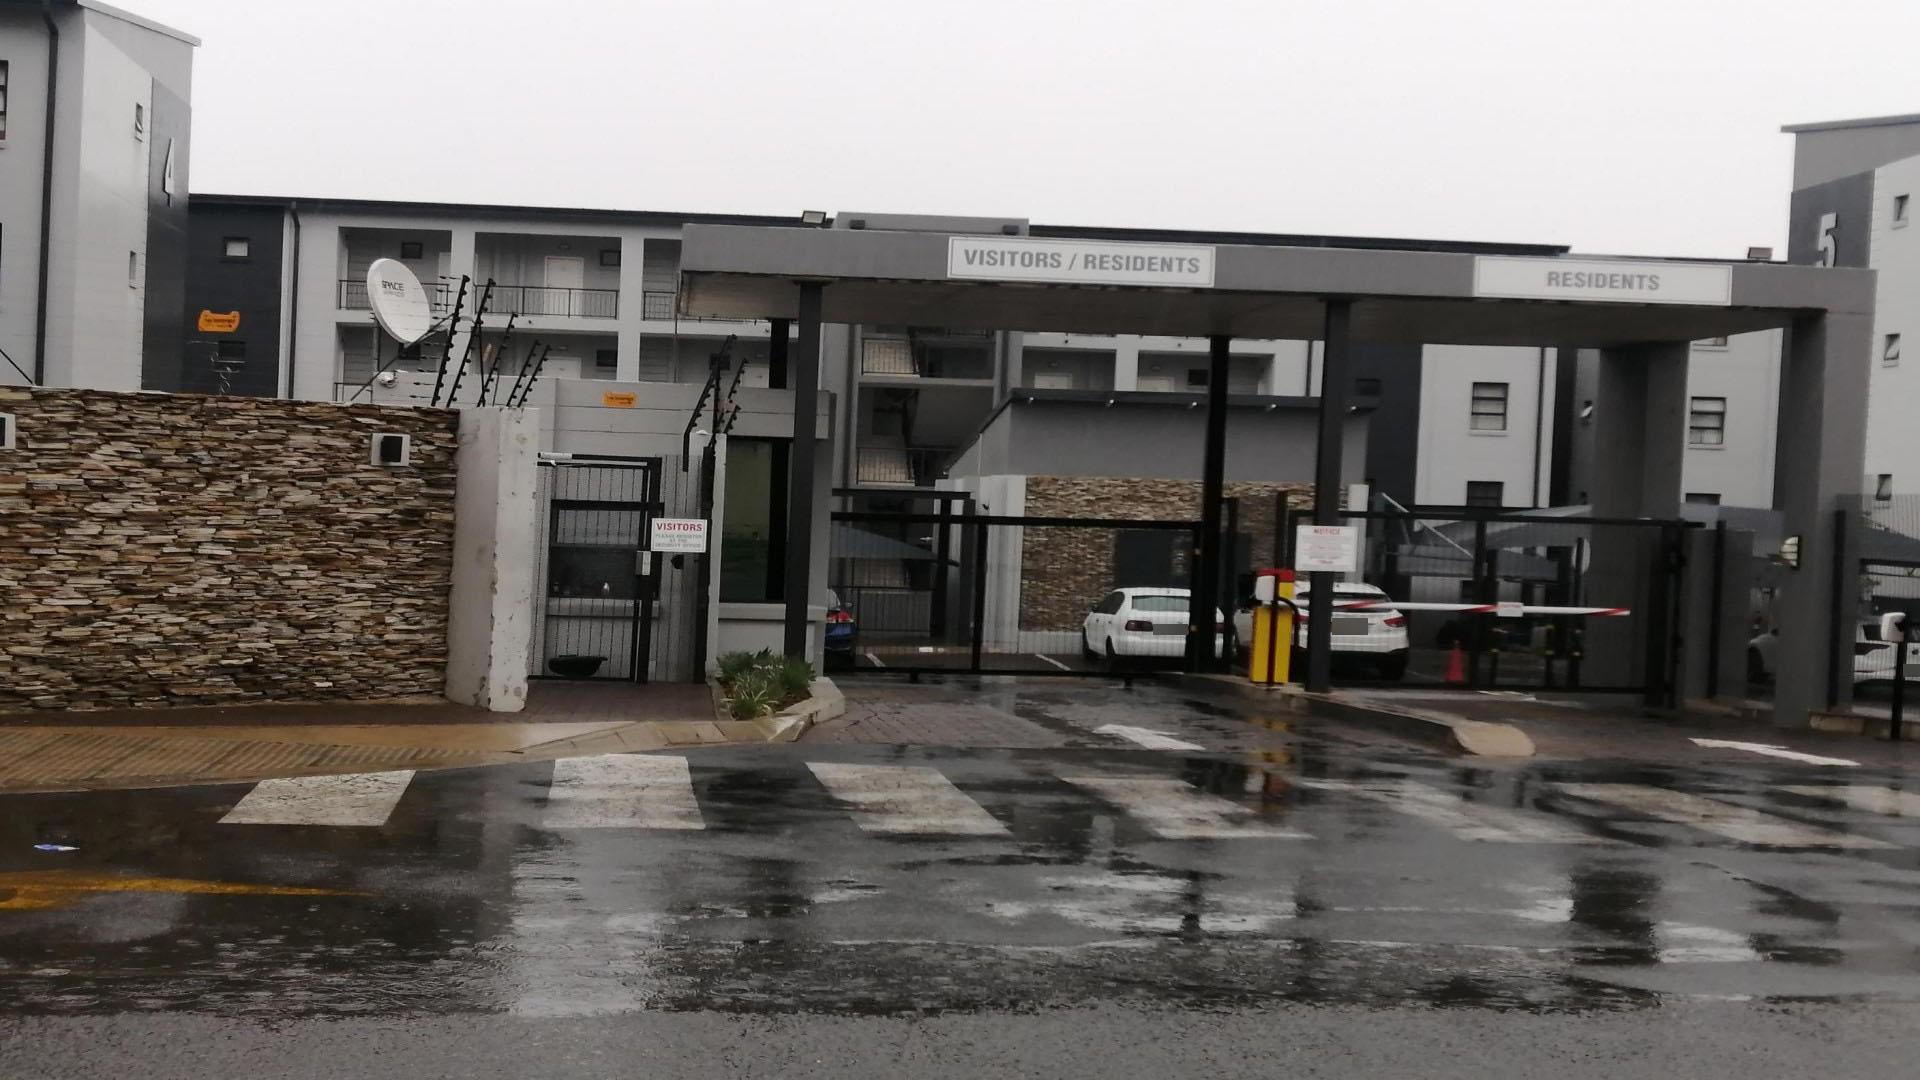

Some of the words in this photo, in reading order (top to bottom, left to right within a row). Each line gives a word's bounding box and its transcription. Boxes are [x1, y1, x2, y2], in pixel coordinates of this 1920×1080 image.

[164, 137, 176, 208] 4
[1814, 212, 1837, 268] 5
[964, 248, 1062, 269] VISITORS
[1068, 253, 1077, 271] /
[1083, 253, 1201, 274] RESIDENTS
[381, 280, 405, 291] SPACE
[1547, 270, 1661, 291] RESIDENTS
[656, 522, 703, 532] VISITORS
